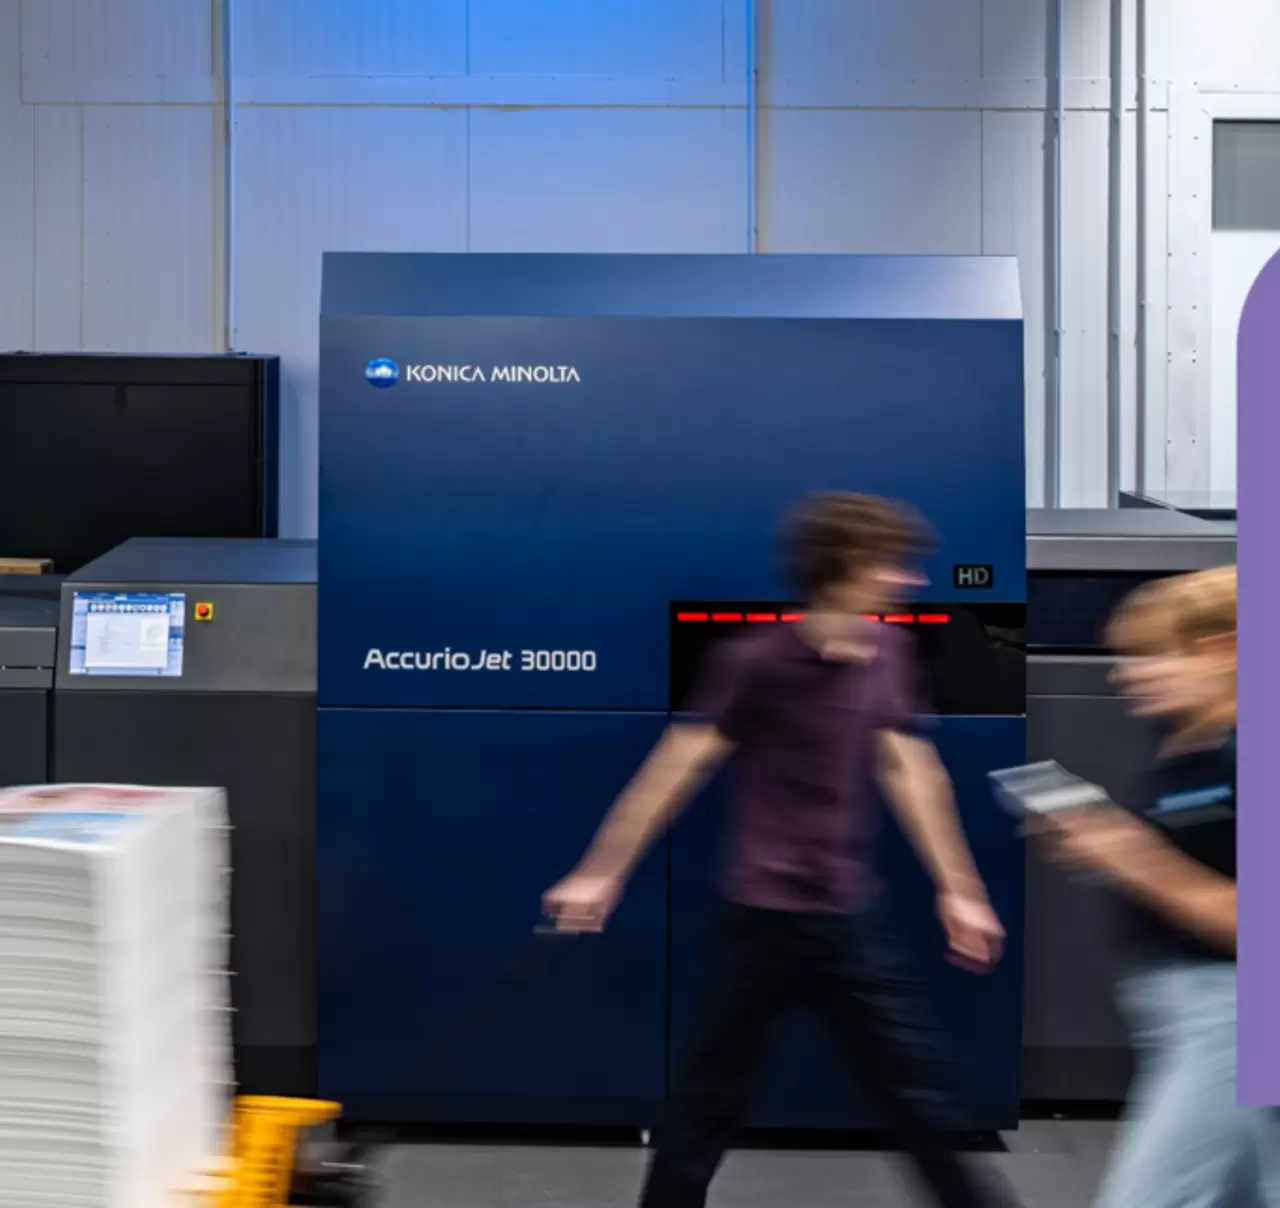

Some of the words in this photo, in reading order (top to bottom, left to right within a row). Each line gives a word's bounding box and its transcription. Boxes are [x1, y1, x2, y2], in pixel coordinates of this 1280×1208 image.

[407, 364, 487, 383] KONICA
[490, 365, 581, 383] MINOLTA
[958, 567, 989, 585] HD
[363, 648, 512, 670] AccurioJet
[521, 650, 596, 671] 30000
